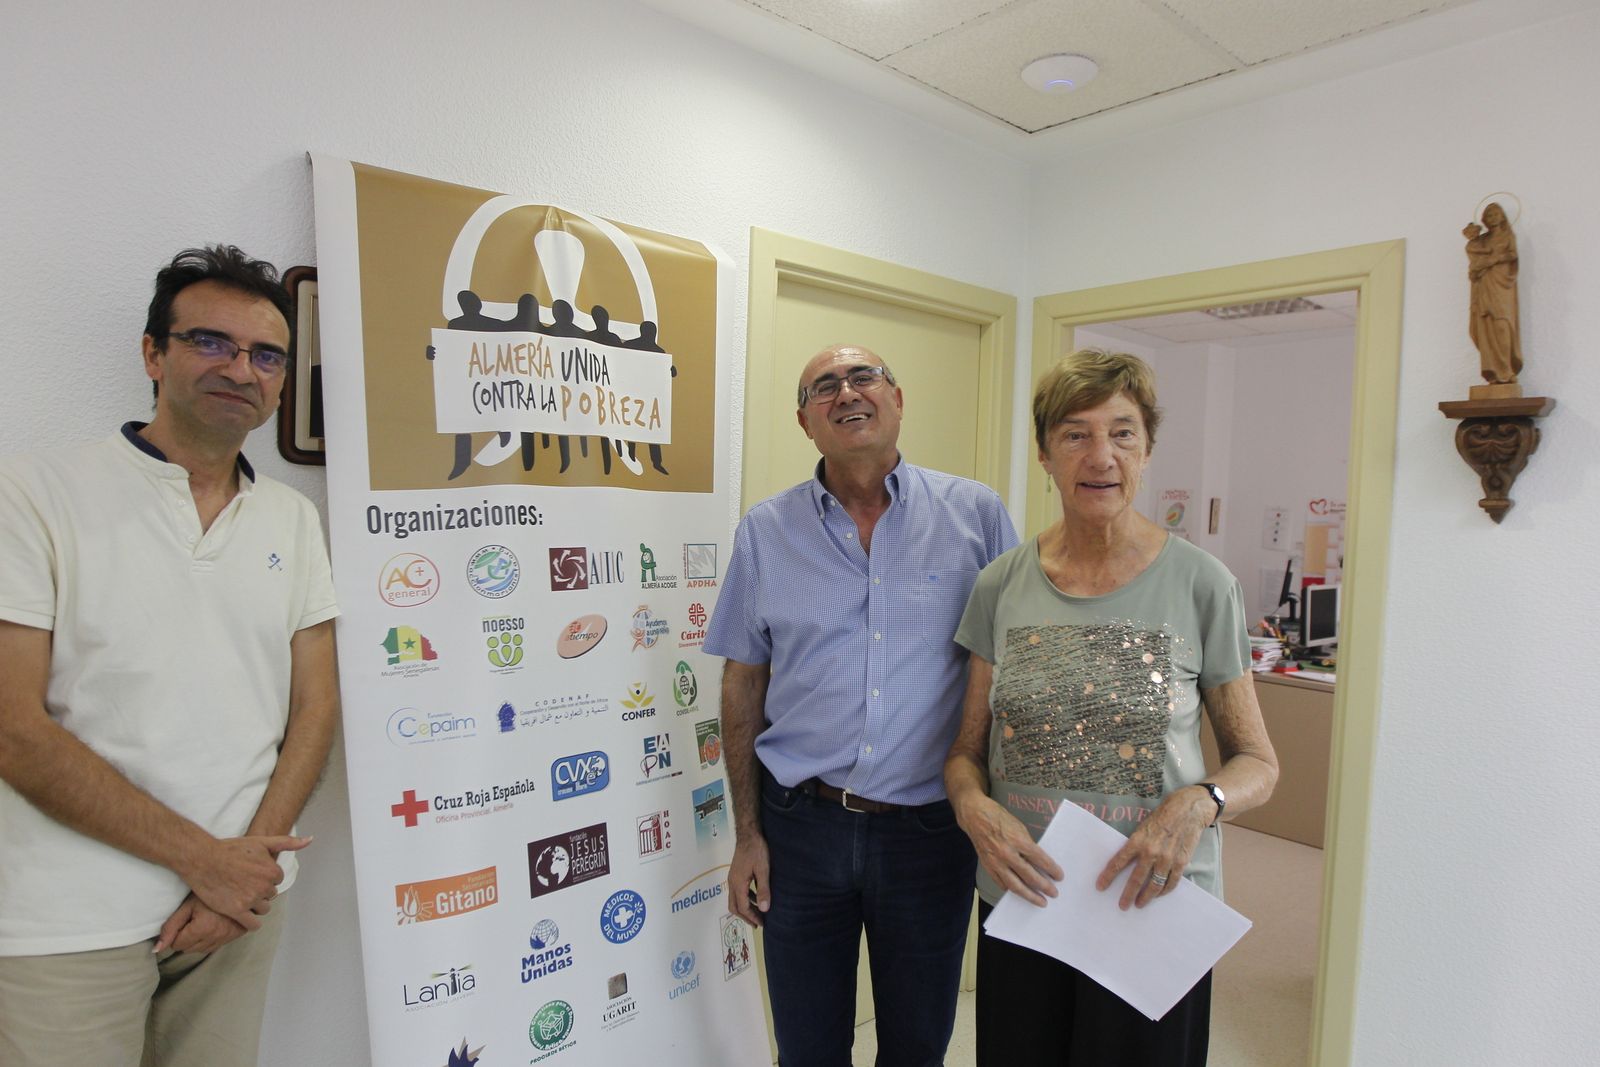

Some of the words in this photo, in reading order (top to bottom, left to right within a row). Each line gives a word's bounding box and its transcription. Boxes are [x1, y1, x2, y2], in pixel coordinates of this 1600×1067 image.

[468, 335, 554, 380] ALMERÍA
[560, 346, 611, 386] UNIDA
[472, 379, 536, 415] CONTRA
[541, 384, 557, 414] LA
[560, 384, 662, 431] POBREZA
[366, 500, 543, 539] Organizaciones:
[388, 587, 432, 602] general
[687, 579, 718, 589] APDHA
[482, 617, 525, 633] noesso
[681, 629, 707, 641] Cárit
[535, 693, 590, 707] CODENAF
[622, 707, 656, 721] CONFER
[398, 716, 475, 738] Cepaim
[434, 796, 463, 811] Cruz
[465, 789, 490, 808] Roja
[492, 778, 535, 801] Española
[1008, 792, 1096, 816] PASSENR
[435, 814, 459, 824] Oficina
[663, 809, 671, 849] HOAC
[570, 834, 605, 860] JESUS
[571, 851, 607, 876] PEREGRIN
[435, 884, 495, 915] Gitano
[603, 923, 615, 940] DEL
[616, 916, 643, 942] MUNDO
[521, 943, 572, 970] Manos
[521, 956, 573, 984] Unidas
[669, 973, 700, 1000] unicef
[603, 1000, 637, 1023] UGARIT
